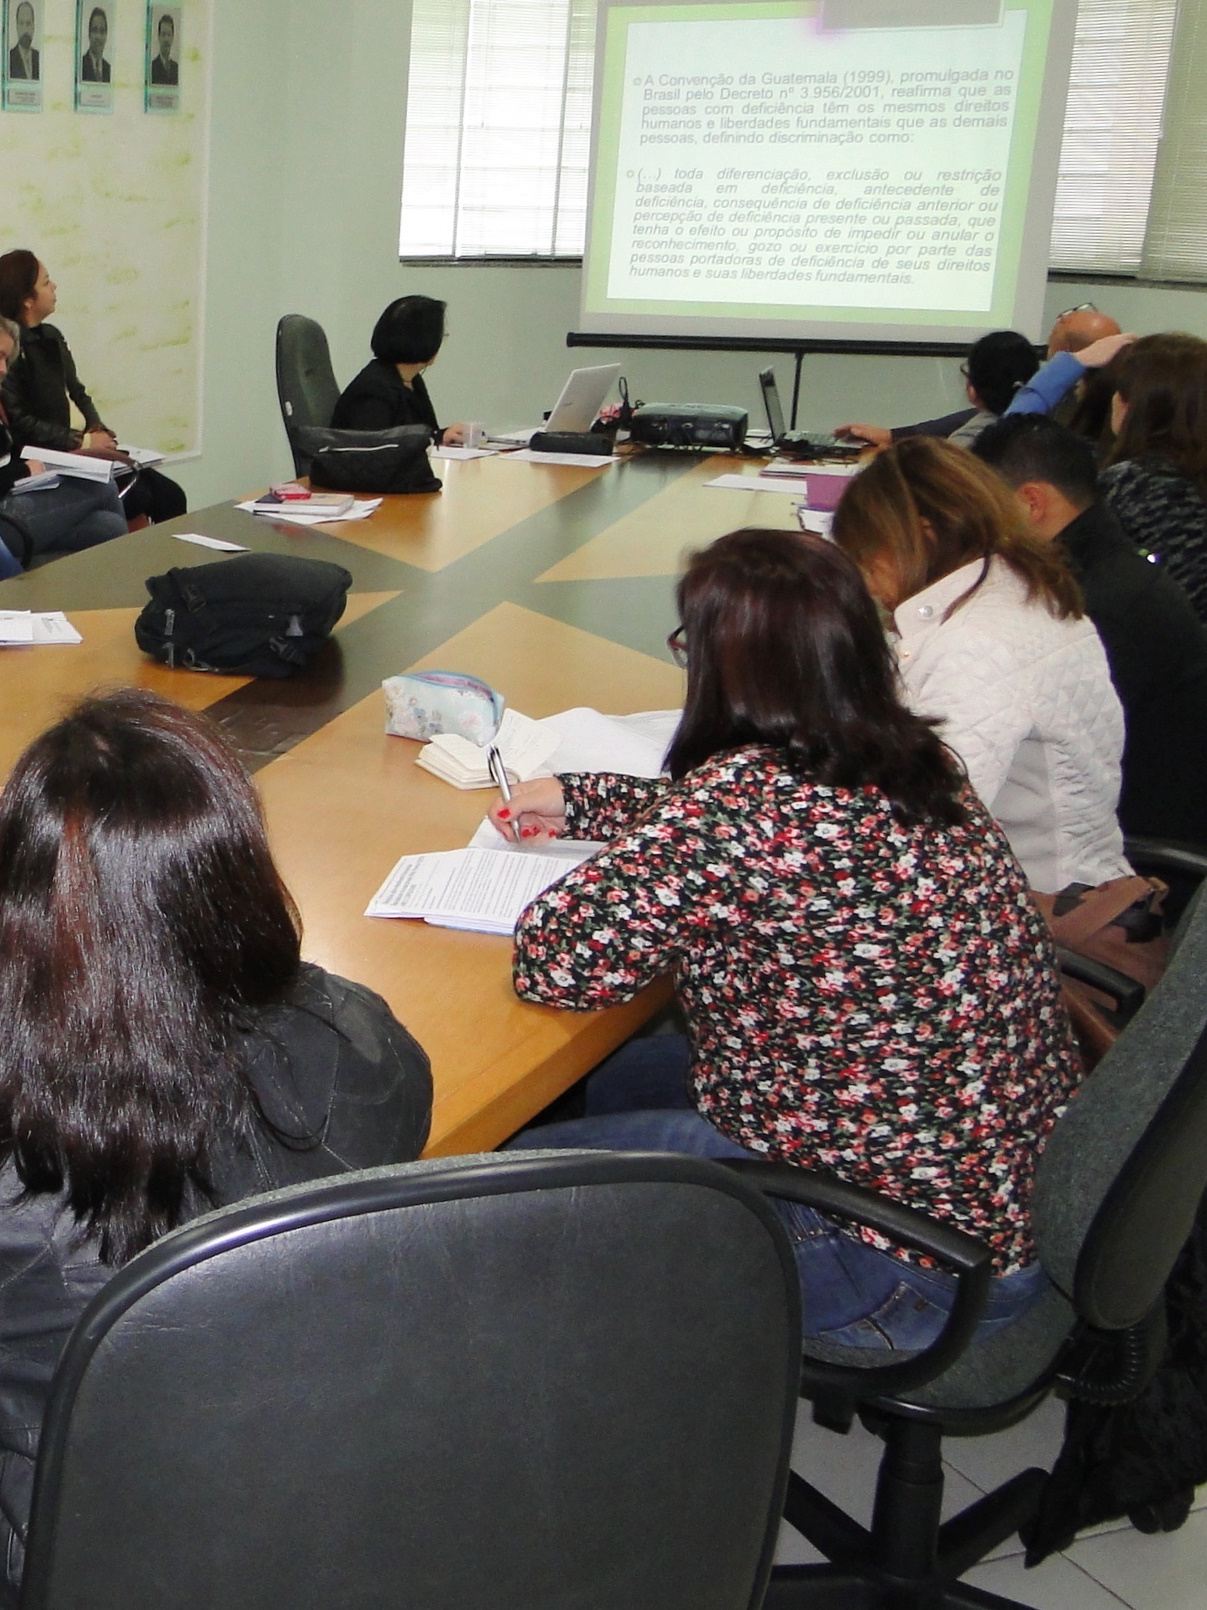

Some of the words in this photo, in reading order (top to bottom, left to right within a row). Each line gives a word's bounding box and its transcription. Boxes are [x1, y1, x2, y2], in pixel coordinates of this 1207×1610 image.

[644, 75, 654, 85] A
[658, 74, 733, 87] Convenção
[738, 73, 755, 83] da
[761, 72, 837, 83] Guatemala
[900, 69, 988, 82] promulgada
[994, 71, 1013, 79] no
[643, 90, 680, 100] Brasil
[685, 89, 713, 101] pelo
[719, 89, 773, 99] Decreto
[891, 86, 950, 97] reafirma
[957, 88, 985, 98] que
[993, 87, 1010, 95] as
[642, 106, 696, 117] pessoas
[704, 106, 733, 114] com
[741, 103, 813, 114] deficiência
[822, 103, 848, 113] têm
[857, 104, 874, 112] os
[882, 104, 944, 112] mesmos
[953, 101, 1008, 112] direitos
[641, 118, 701, 128] humanos
[706, 120, 714, 128] e
[720, 118, 789, 128] liberdades
[796, 117, 890, 127] fundamentais
[896, 119, 924, 129] que
[929, 119, 946, 127] as
[952, 117, 1006, 127] demais
[702, 133, 763, 142] definindo
[768, 133, 863, 145] discriminação
[674, 169, 703, 179] toda
[826, 169, 889, 179] exclusão
[903, 171, 922, 179] ou
[936, 170, 1001, 183] restrição
[635, 182, 692, 192] baseada
[715, 185, 737, 193] em
[863, 184, 953, 194] antecedente
[979, 184, 1000, 195] de
[713, 198, 807, 210] consequência
[812, 199, 829, 209] de
[835, 199, 910, 209] deficiência
[916, 200, 973, 210] anterior
[978, 202, 997, 210] ou
[633, 211, 702, 224] percepção
[707, 212, 723, 222] de
[728, 212, 800, 223] deficiência
[805, 213, 866, 226] presente
[872, 216, 889, 224] ou
[967, 217, 995, 227] que
[632, 225, 668, 235] tenha
[674, 227, 683, 235] o
[688, 226, 725, 236] efeito
[731, 228, 748, 236] ou
[754, 227, 817, 240] propósito
[824, 228, 841, 238] de
[847, 228, 900, 241] impedir
[906, 231, 925, 239] ou
[931, 230, 978, 240] anular
[984, 233, 994, 241] o
[748, 243, 781, 253] gozo
[789, 243, 806, 252] ou
[815, 242, 878, 253] exercício
[885, 245, 911, 256] por
[917, 244, 956, 257] parte
[964, 245, 992, 256] das
[629, 255, 684, 265] pessoas
[689, 254, 761, 267] portadoras
[768, 256, 784, 266] de
[791, 256, 864, 267] deficiência
[871, 258, 888, 268] de
[895, 260, 929, 268] seus
[936, 259, 990, 270] direitos
[629, 267, 688, 277] humanos
[692, 270, 700, 278] e
[706, 270, 736, 279] suas
[740, 269, 811, 280] liberdades
